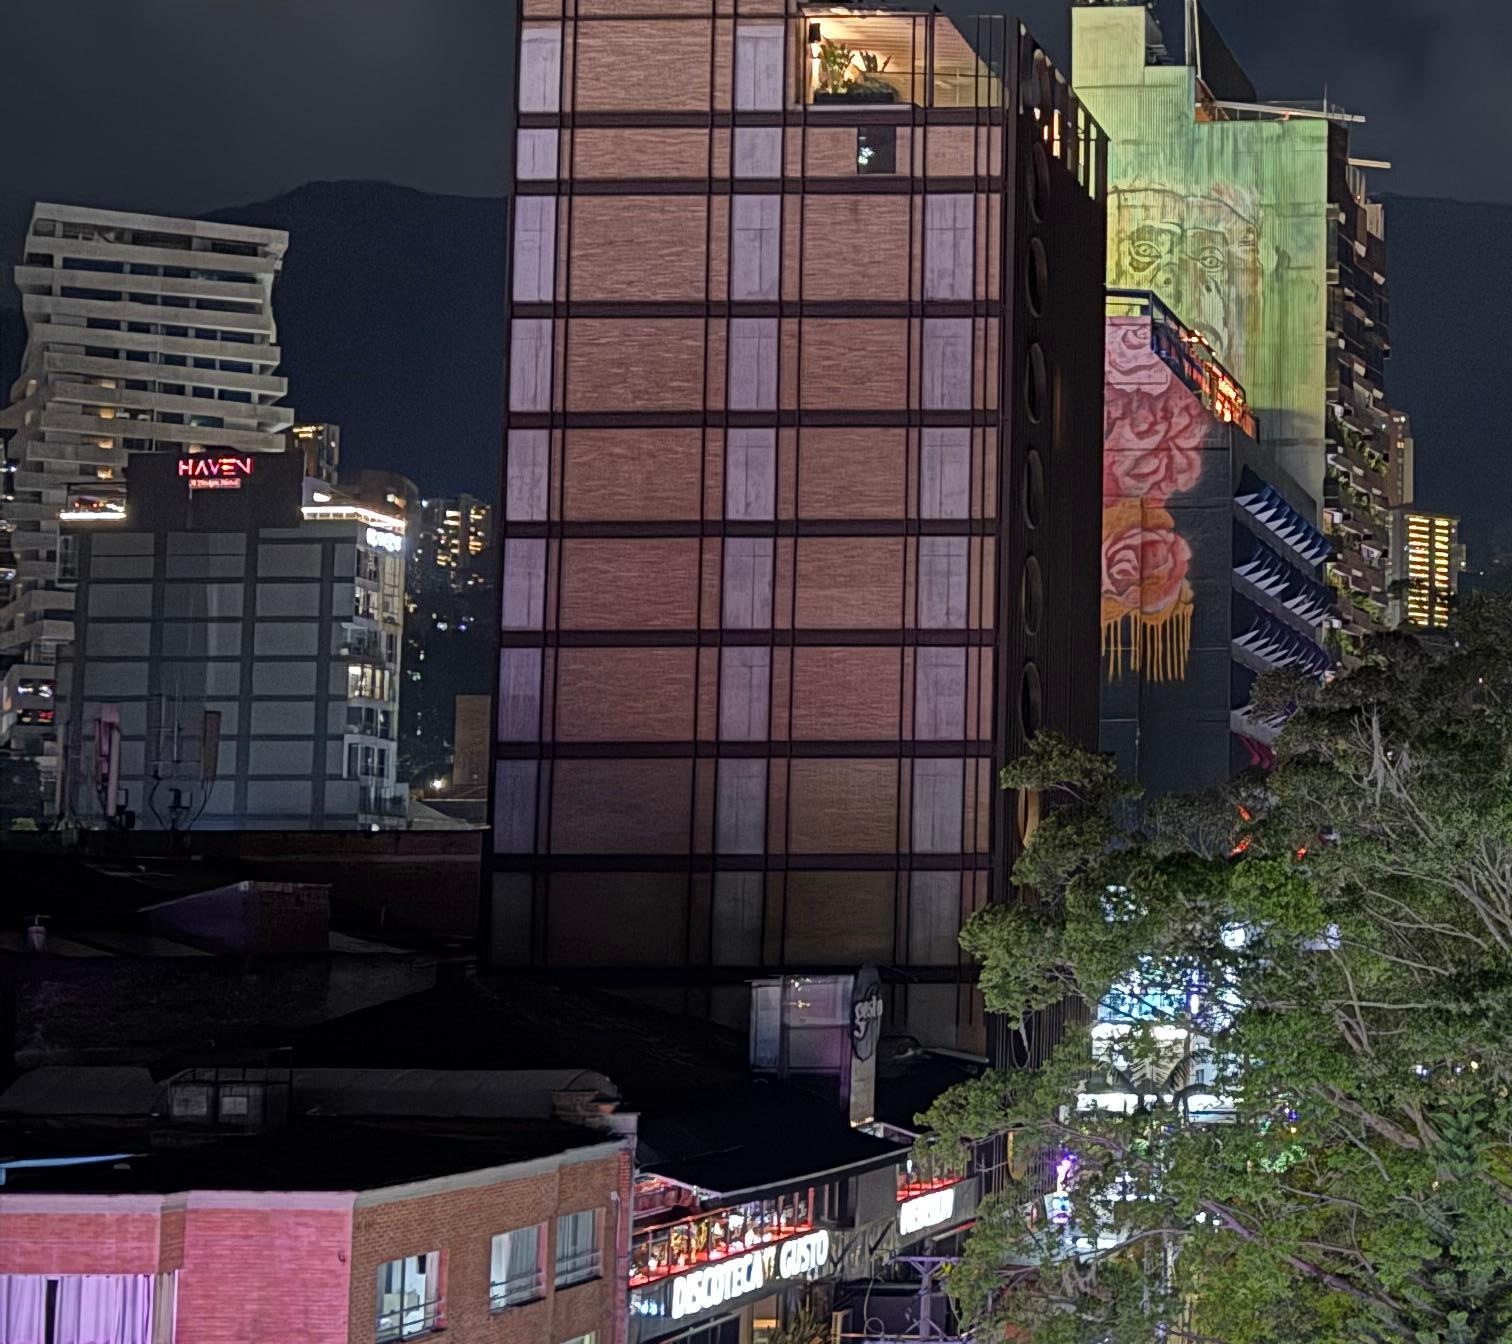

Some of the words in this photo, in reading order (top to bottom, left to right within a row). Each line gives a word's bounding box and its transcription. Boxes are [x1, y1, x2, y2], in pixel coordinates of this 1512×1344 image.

[178, 457, 252, 476] HAVEN
[672, 1251, 764, 1320] DISCOTECA
[779, 1229, 829, 1279] GUSTO
